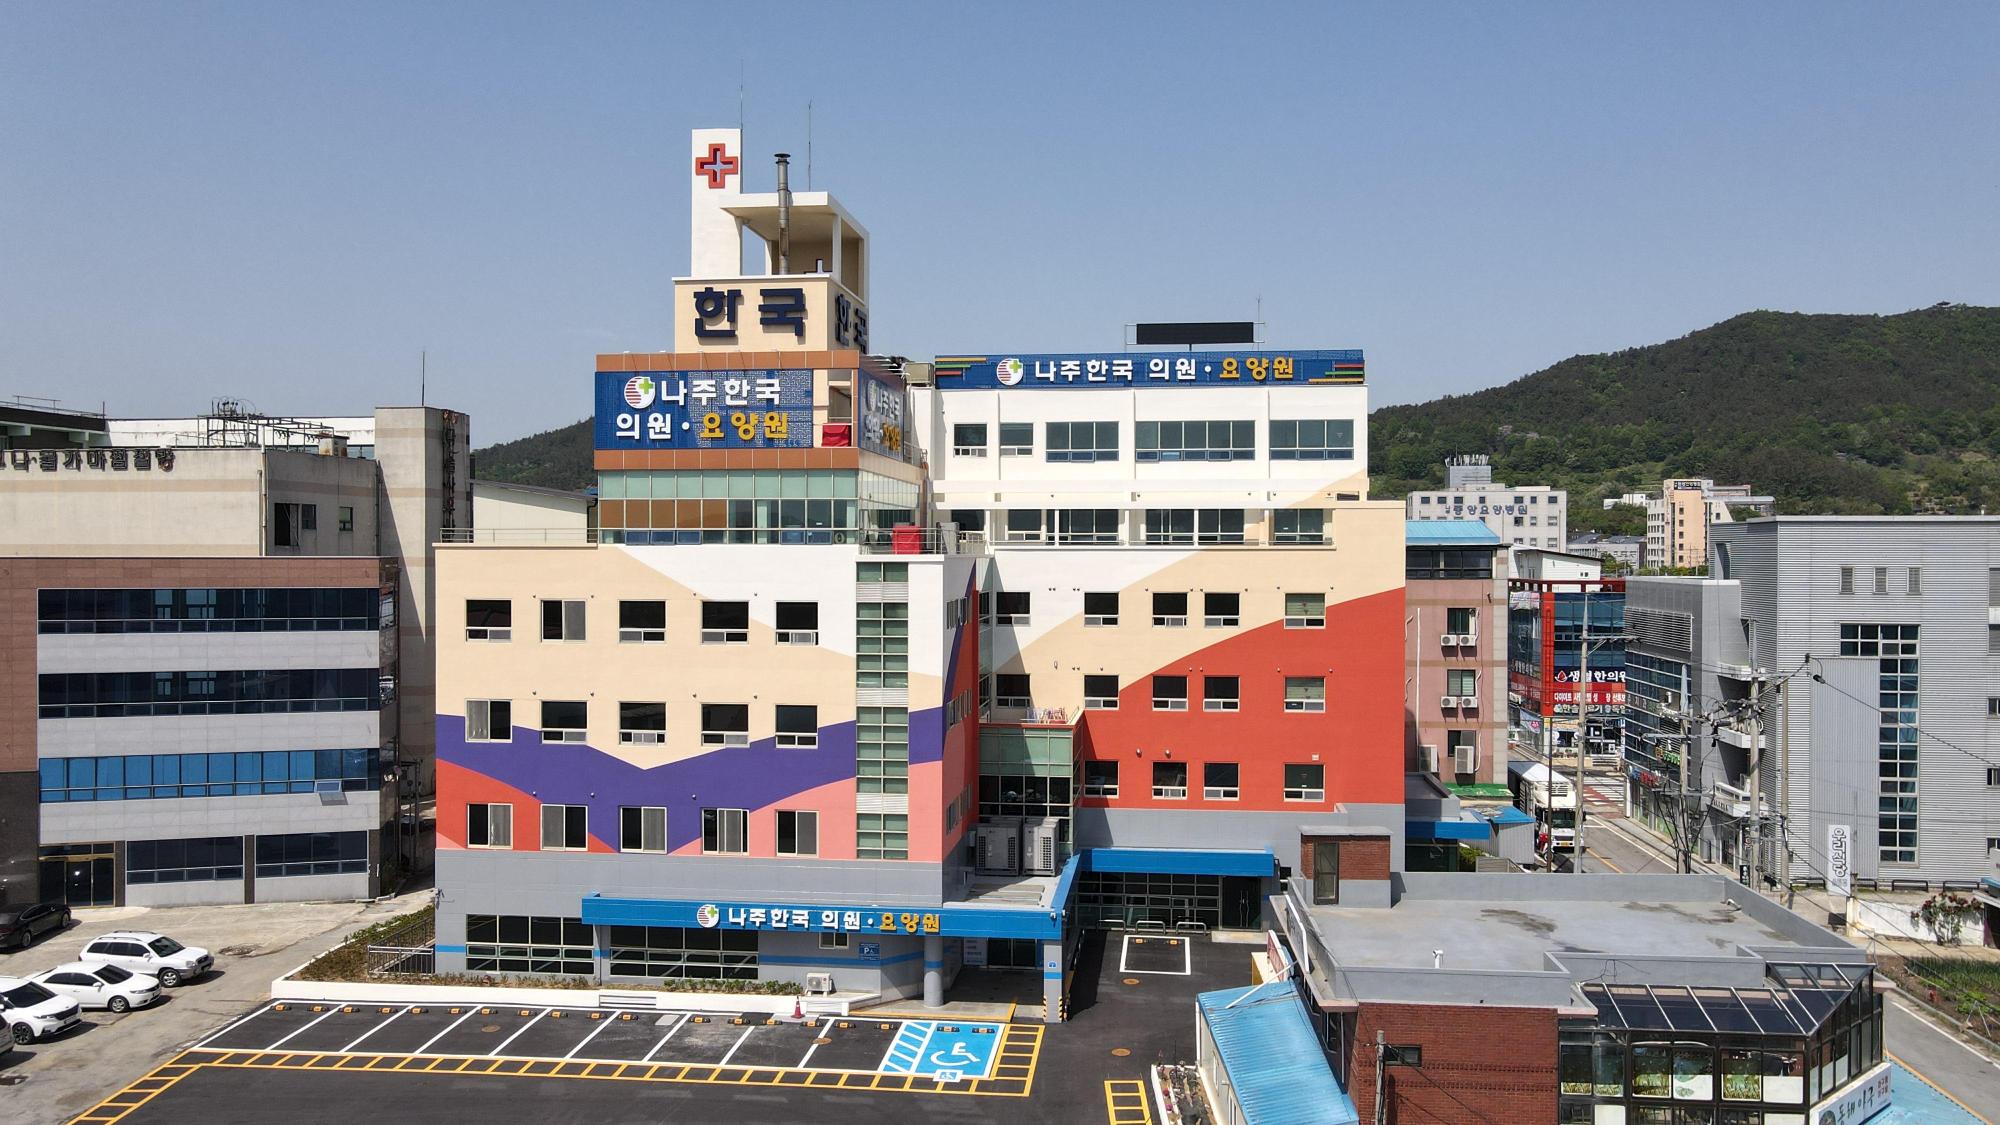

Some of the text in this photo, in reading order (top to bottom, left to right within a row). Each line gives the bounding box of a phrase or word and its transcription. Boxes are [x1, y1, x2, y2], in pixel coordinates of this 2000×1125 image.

[693, 287, 806, 337] 한국
[1035, 359, 1133, 382] 나주한국
[1219, 357, 1293, 381] 요양원
[661, 378, 781, 406] 나주한국
[700, 411, 788, 441] 요양원
[728, 907, 809, 928] 나주한국
[879, 911, 941, 933] 요양원
